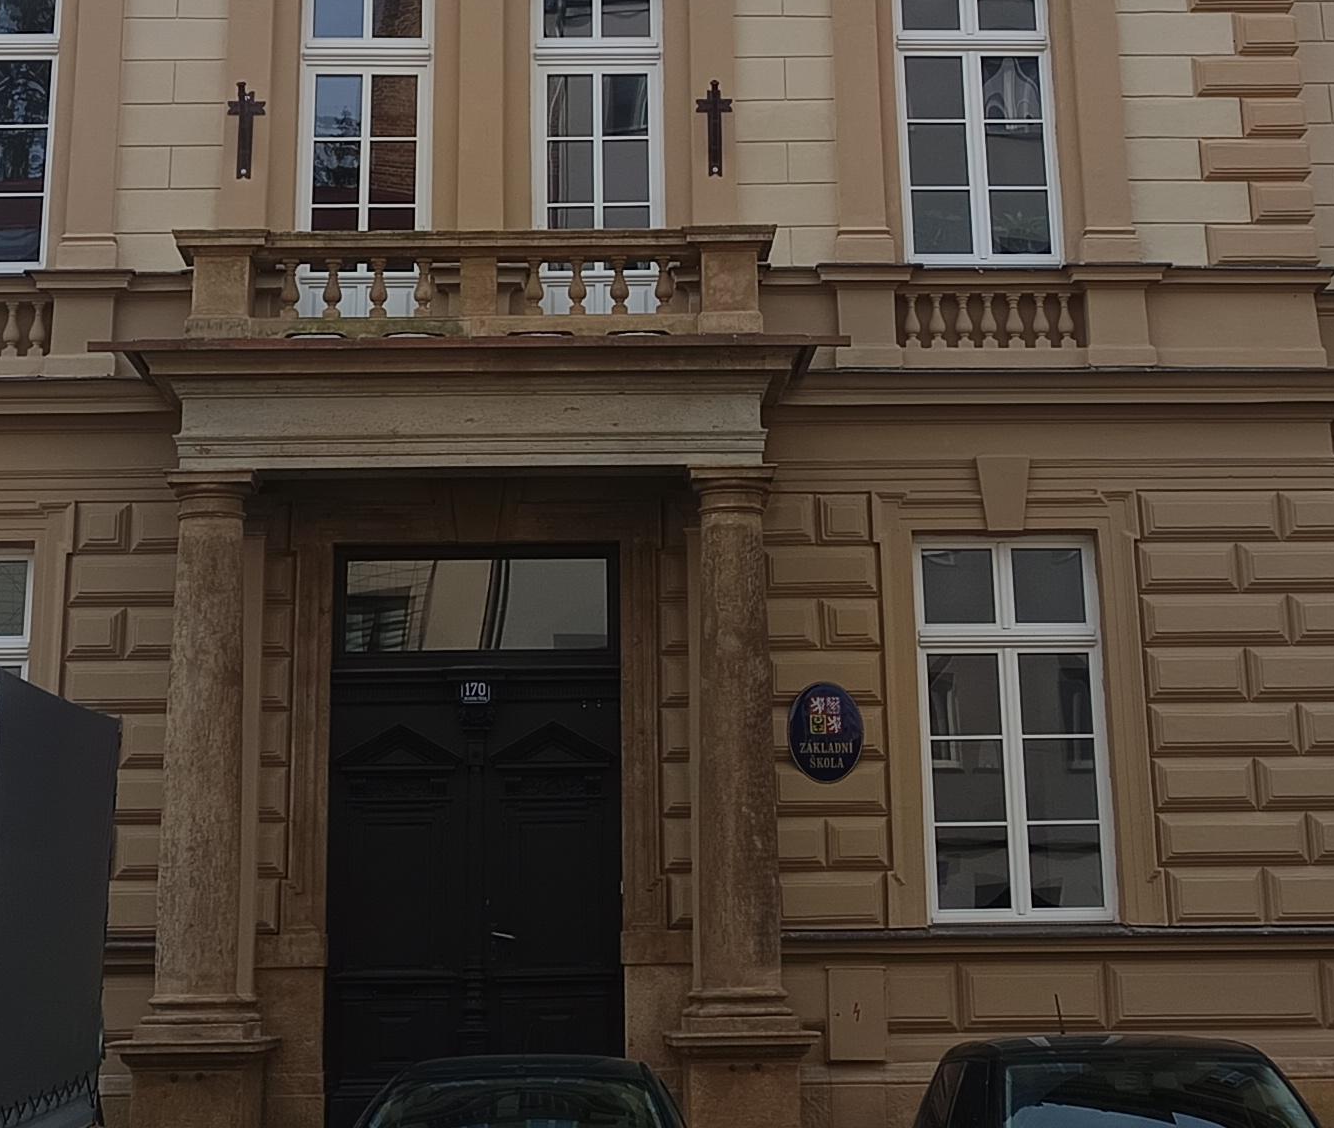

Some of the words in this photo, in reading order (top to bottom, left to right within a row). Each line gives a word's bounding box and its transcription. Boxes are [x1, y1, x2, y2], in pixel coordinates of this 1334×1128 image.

[465, 682, 486, 696] 170
[799, 739, 854, 754] ZÁKLADNÍ
[809, 754, 844, 769] ŠKOLA
